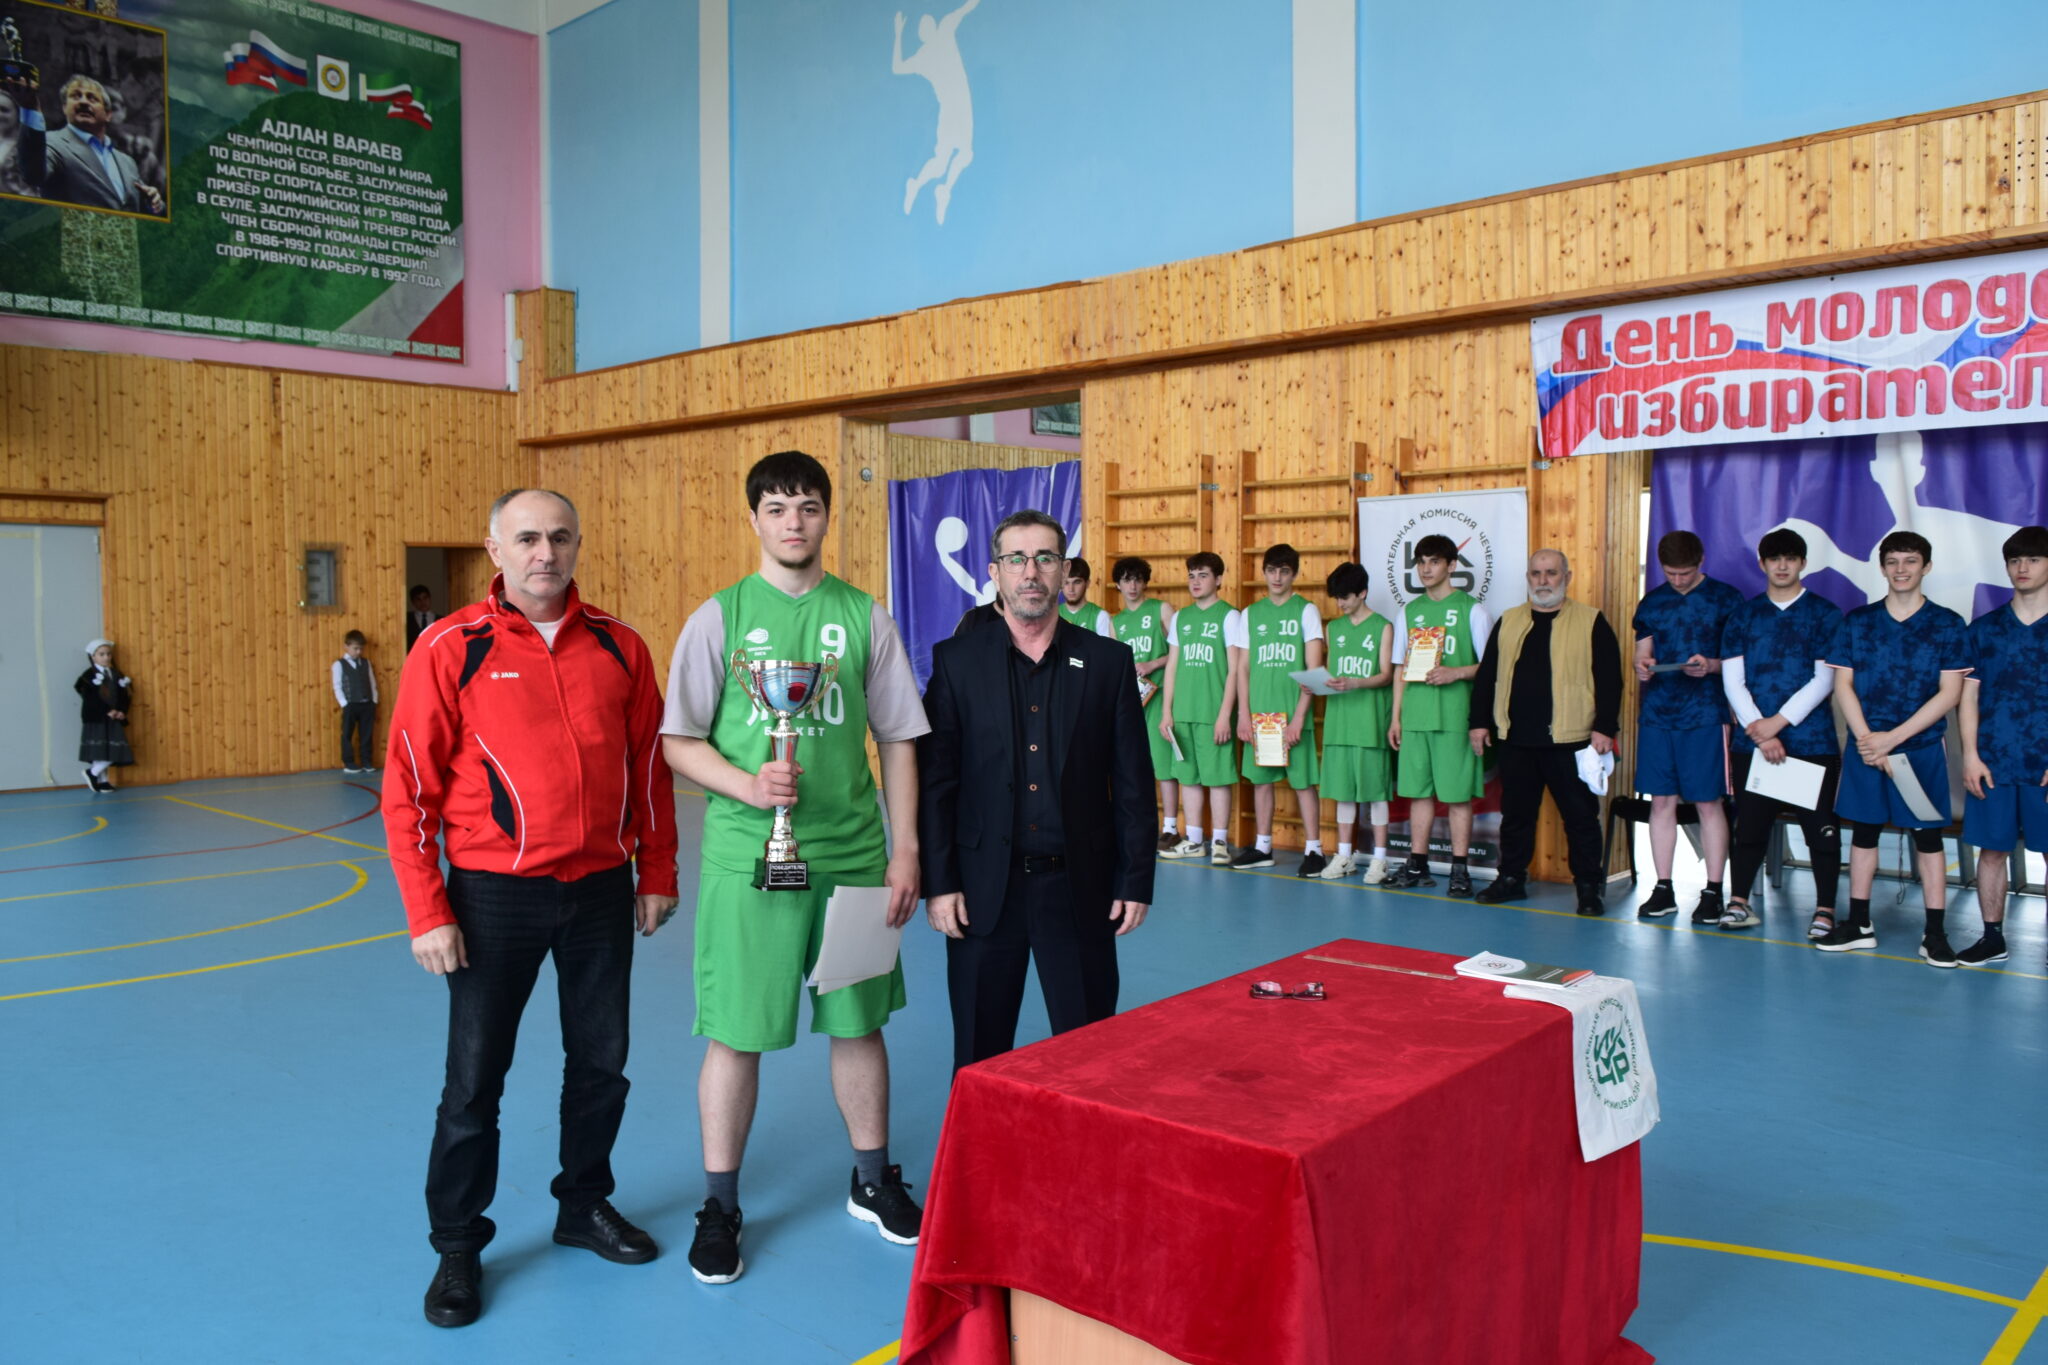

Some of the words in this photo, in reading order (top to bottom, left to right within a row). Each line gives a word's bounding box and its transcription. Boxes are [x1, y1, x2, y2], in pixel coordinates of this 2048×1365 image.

[227, 132, 293, 156] ЧЕМПИОН
[332, 153, 385, 175] ЕВРОПЫ
[388, 165, 397, 177] И
[400, 168, 433, 184] МИРА
[261, 118, 328, 147] АДЛАН
[333, 132, 403, 162] ВАРАЕВ
[209, 145, 229, 159] ПО
[232, 149, 297, 172] ВОЛЬНОЙ
[356, 173, 448, 202] ЗАСЛУЖЕННЫЙ
[216, 162, 271, 182] МАСТЕР
[274, 173, 324, 193] СПОРТА
[362, 190, 443, 215] СЕРЕБРЯНЫЙ
[197, 192, 207, 204] В
[259, 202, 360, 229] ЗАСЛУЖЕННЫЙ
[363, 220, 408, 237] ТРЕНЕР
[207, 177, 261, 196] ПРИЗЁР
[264, 187, 361, 215] ОЛИМПИЙСКИХ
[364, 205, 388, 219] ИГР
[391, 210, 417, 225] 1988
[419, 217, 451, 232] ГОДА
[221, 211, 257, 228] ЧЛЕН
[260, 218, 321, 238] СБОРНОЙ
[325, 229, 389, 250] КОМАНДЫ
[392, 240, 440, 258] СТРАНЫ
[235, 230, 245, 242] В
[248, 232, 311, 252] 1986-1992
[362, 250, 428, 271] ЗАВЕРШИЛ
[216, 243, 308, 267] СПОРТИВНУЮ
[311, 257, 368, 276] КАРЬЕРУ
[371, 267, 379, 278] В
[383, 269, 408, 283] 1992
[1553, 310, 1735, 375] День
[1387, 518, 1416, 607] ИЗБИРАТЕЛЬНАЯ
[1420, 508, 1477, 530] КОМИССИЯ
[1479, 531, 1494, 604] ЧЕЧЕНСКОЙ
[1141, 615, 1152, 629] 8
[1200, 622, 1219, 639] 12
[1278, 619, 1299, 636] 10
[1444, 609, 1458, 627] 5
[820, 623, 847, 660] 9
[1124, 635, 1152, 654] ОКО
[1257, 642, 1296, 664] ЛОКО
[1362, 634, 1375, 652] 4
[764, 726, 826, 737] БКЕТ
